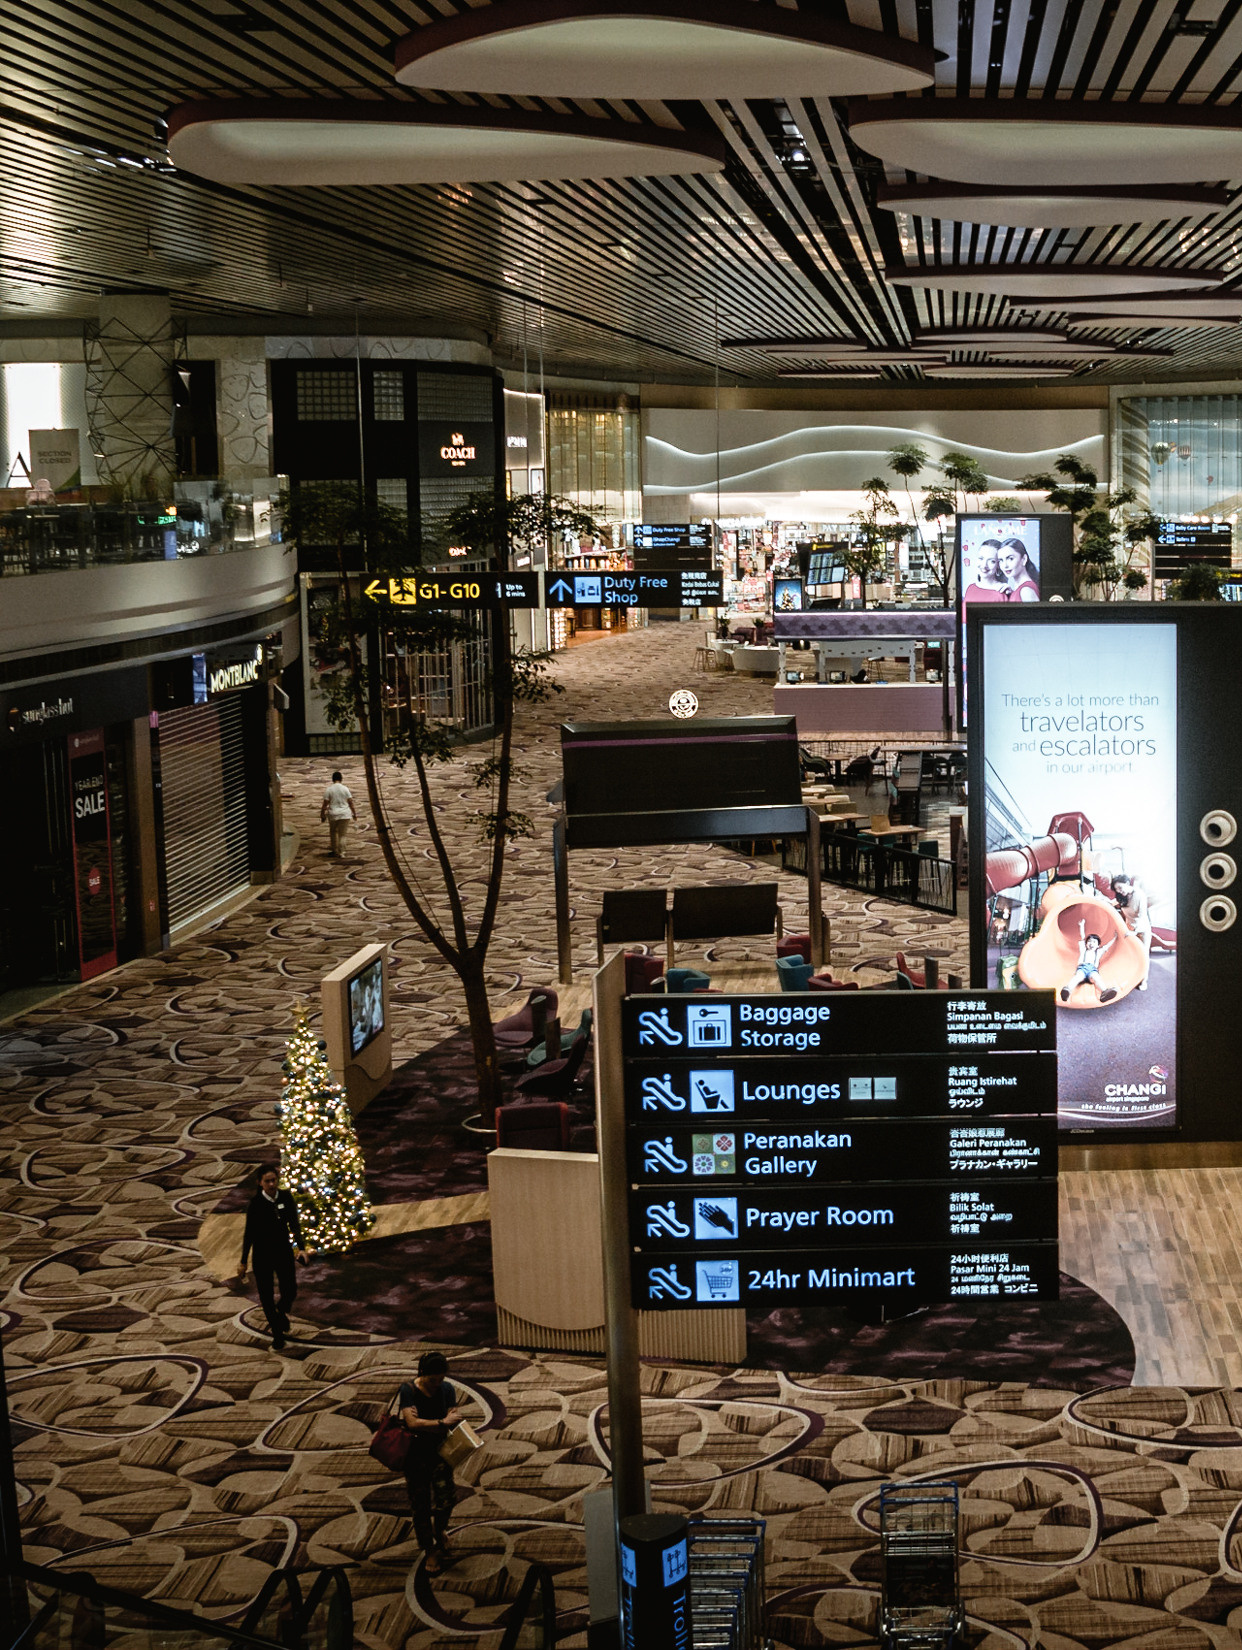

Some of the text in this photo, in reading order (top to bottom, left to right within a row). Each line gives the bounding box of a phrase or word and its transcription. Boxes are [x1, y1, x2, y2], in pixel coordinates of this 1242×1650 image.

[441, 447, 476, 459] COACH
[604, 576, 668, 590] Duty Free
[420, 584, 440, 599] G1
[450, 584, 480, 599] G10
[605, 592, 638, 606] Shop
[210, 660, 258, 693] MONTBLANC
[1002, 694, 1159, 707] There's a lot more than
[1020, 710, 1144, 732] travelators
[1012, 734, 1156, 756] and escalators
[1047, 761, 1058, 773] in
[1062, 762, 1083, 773] our
[75, 791, 105, 818] SALE
[89, 876, 100, 886] SALE
[740, 1004, 830, 1026] Baggage
[947, 1011, 1024, 1022] Simpanan Bagasi
[741, 1030, 820, 1050] Storage
[948, 1076, 1017, 1088] Ruang Istirehat
[743, 1081, 841, 1105] Lounges
[1104, 1084, 1167, 1096] CHANGI
[949, 1098, 984, 1108] ラウンジ
[744, 1130, 852, 1149] Peranakan
[950, 1138, 1027, 1148] Galeri Peranakan
[745, 1156, 817, 1177] Gallery
[950, 1203, 995, 1212] Bilik Solat
[746, 1206, 894, 1231] Prayer Room
[950, 1264, 1030, 1274] Pasar Mini 24 Jam
[748, 1268, 916, 1289] 24hr Minimart
[1004, 1283, 1039, 1293] コンビニ
